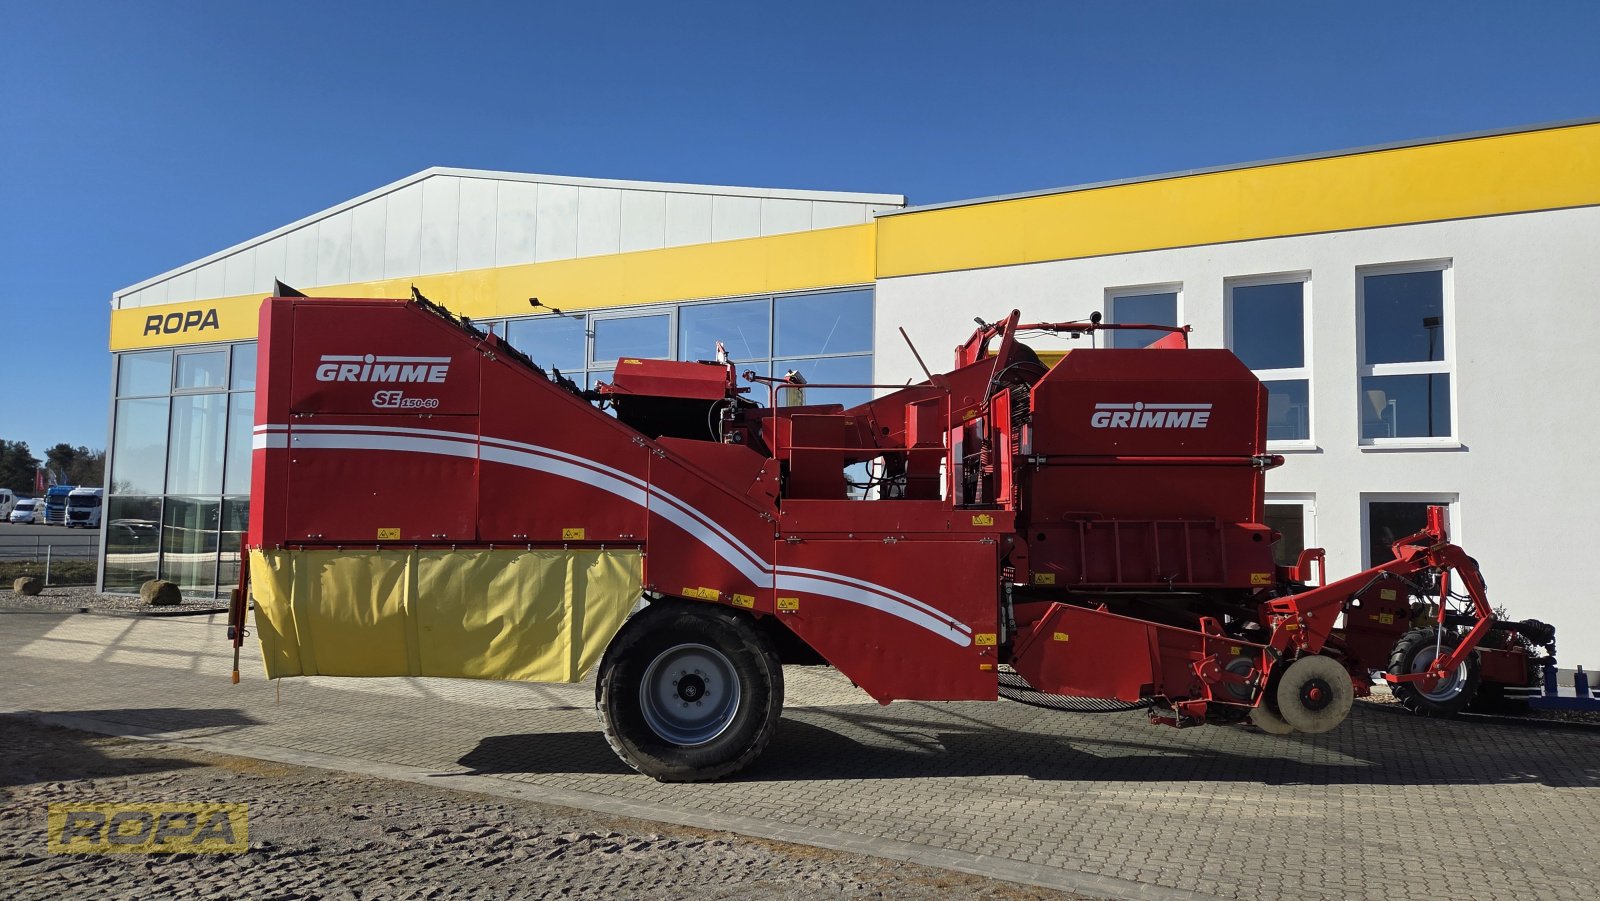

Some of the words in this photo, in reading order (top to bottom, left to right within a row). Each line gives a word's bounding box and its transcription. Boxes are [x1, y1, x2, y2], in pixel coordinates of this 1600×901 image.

[143, 308, 219, 336] ROPA
[315, 354, 451, 383] GRIMME
[371, 390, 403, 408] SE
[401, 398, 439, 408] 150-60
[1091, 401, 1212, 428] GRIMME
